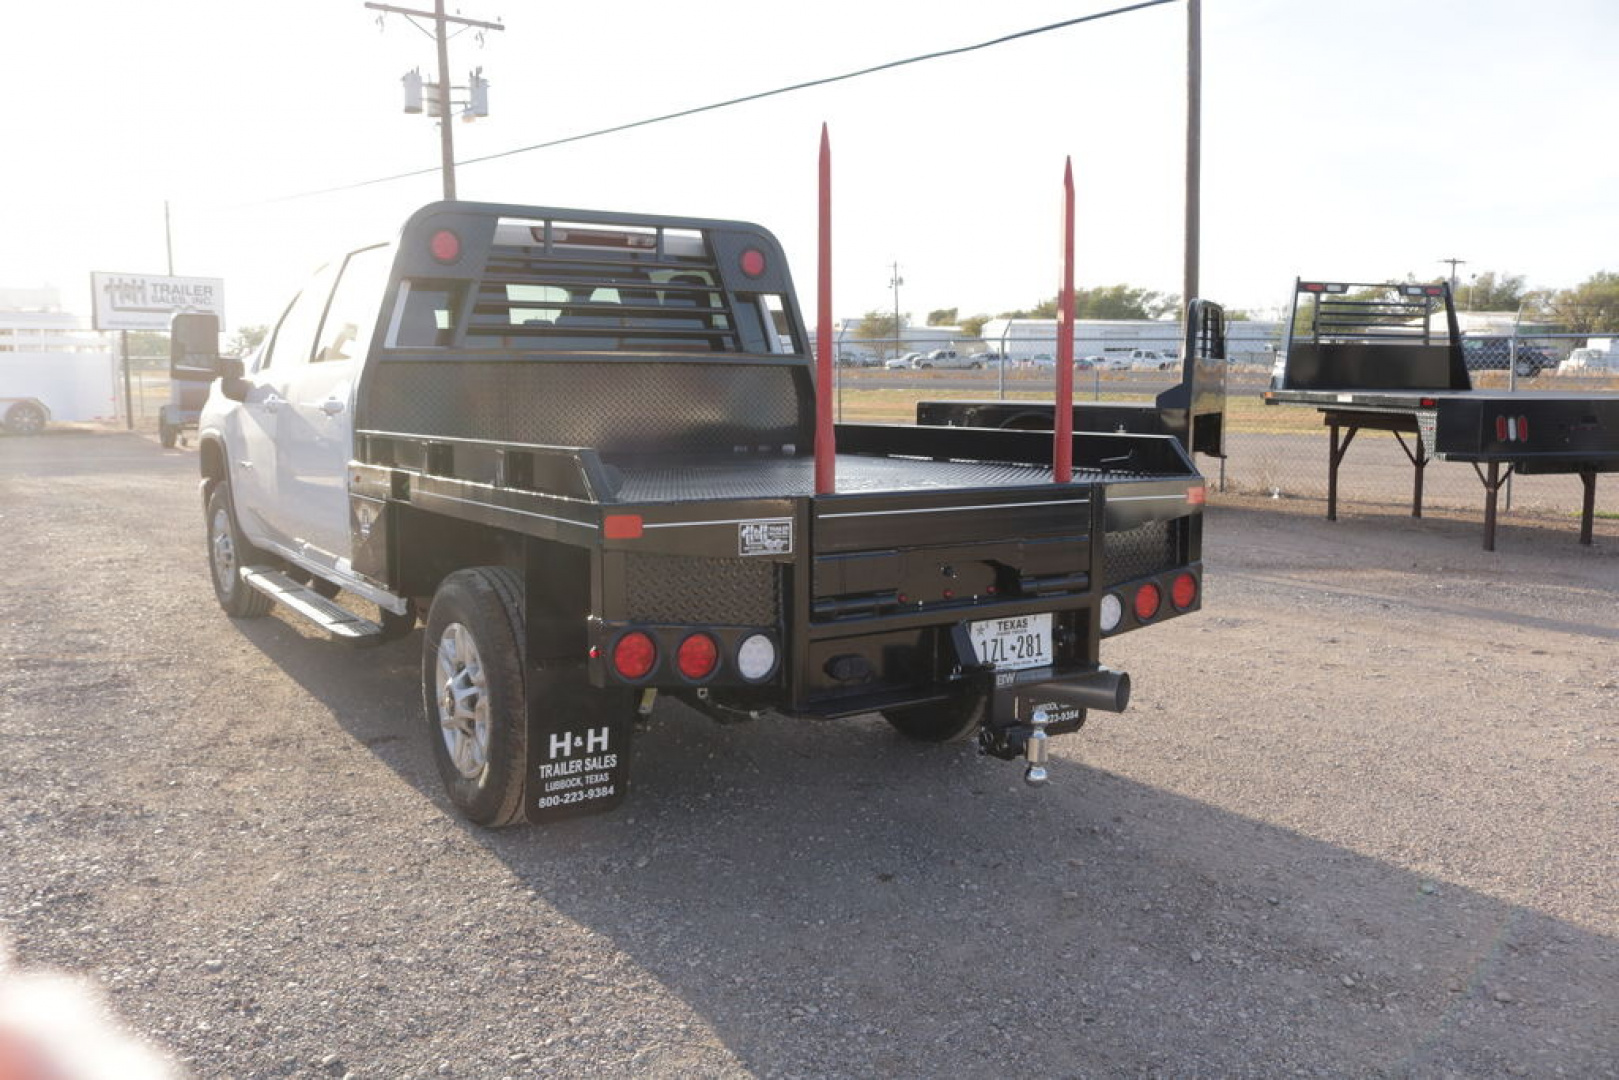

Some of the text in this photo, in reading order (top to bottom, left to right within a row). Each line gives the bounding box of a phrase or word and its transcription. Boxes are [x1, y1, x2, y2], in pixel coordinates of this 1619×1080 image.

[150, 282, 213, 297] TRAILER
[996, 618, 1029, 632] TEXAS
[539, 754, 618, 779] TRAILER SALES
[585, 772, 610, 785] TEXAS
[538, 785, 615, 809] 800-223-9384
